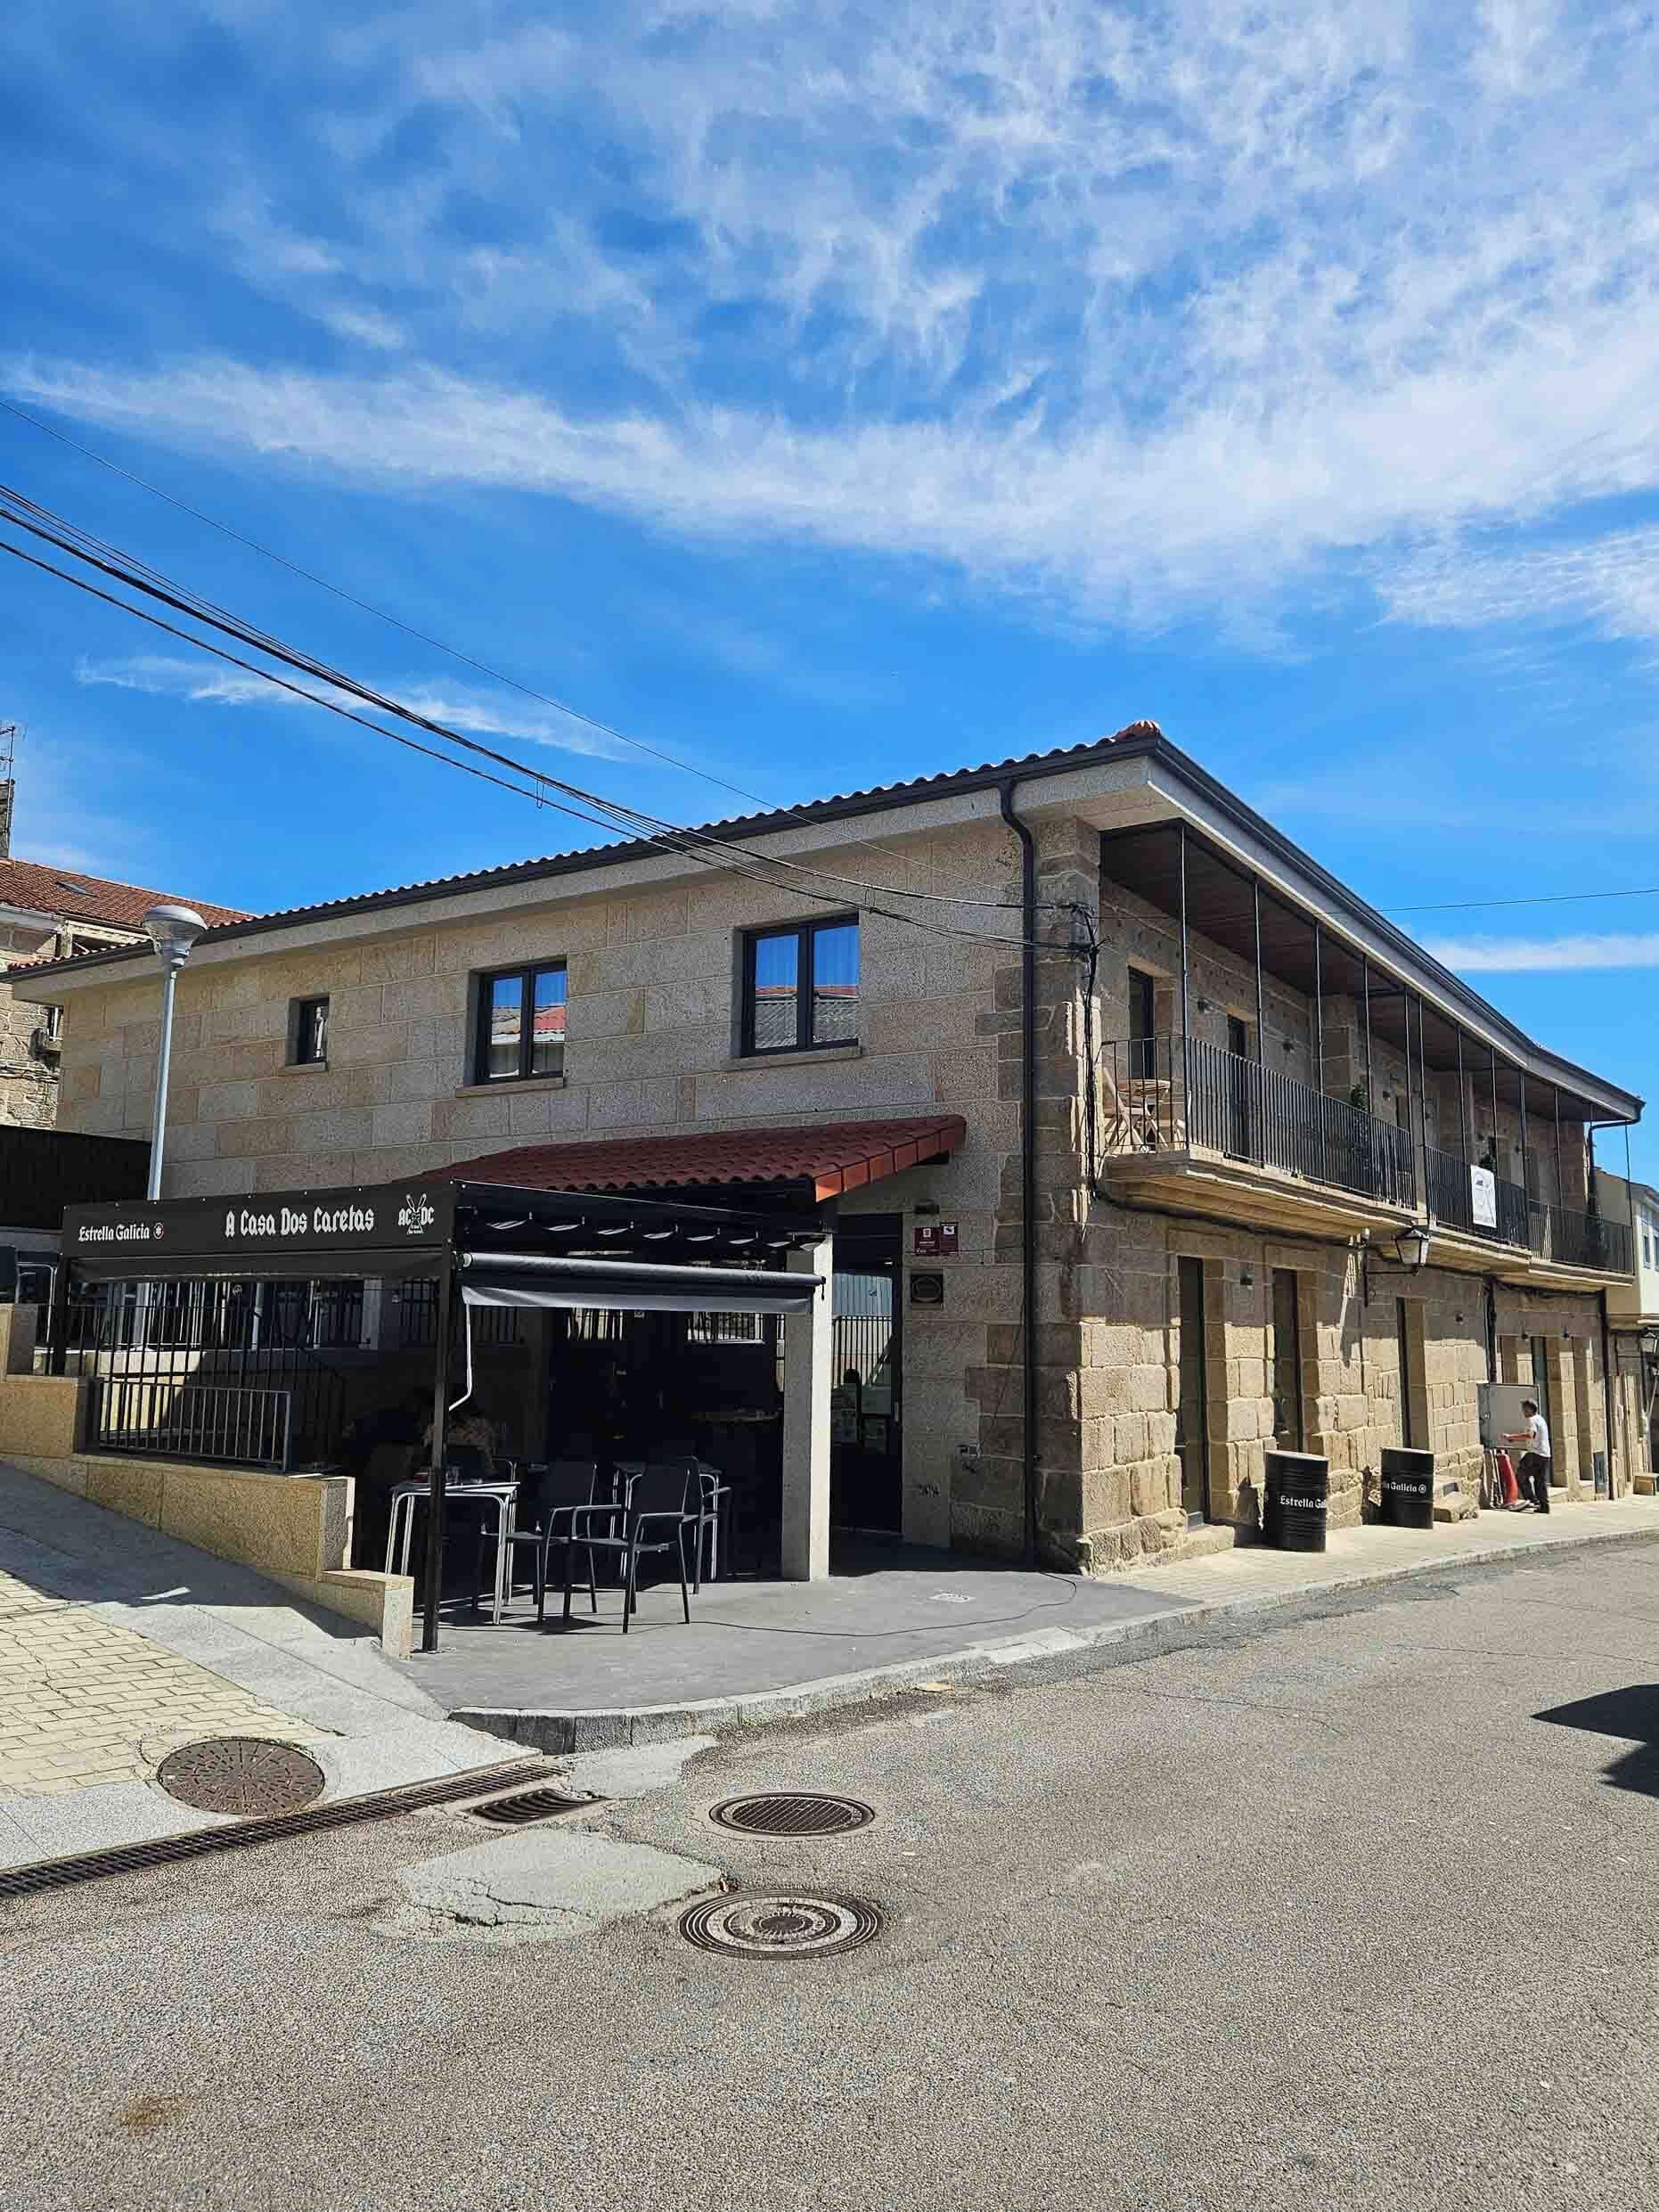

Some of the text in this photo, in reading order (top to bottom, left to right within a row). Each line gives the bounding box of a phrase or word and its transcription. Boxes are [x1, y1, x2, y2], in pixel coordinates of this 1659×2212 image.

[225, 1205, 374, 1238] A Casa Dos Caretas
[78, 1223, 150, 1241] Estrella Galicia
[1390, 1481, 1418, 1492] Galicia
[1279, 1495, 1314, 1508] Estrella
